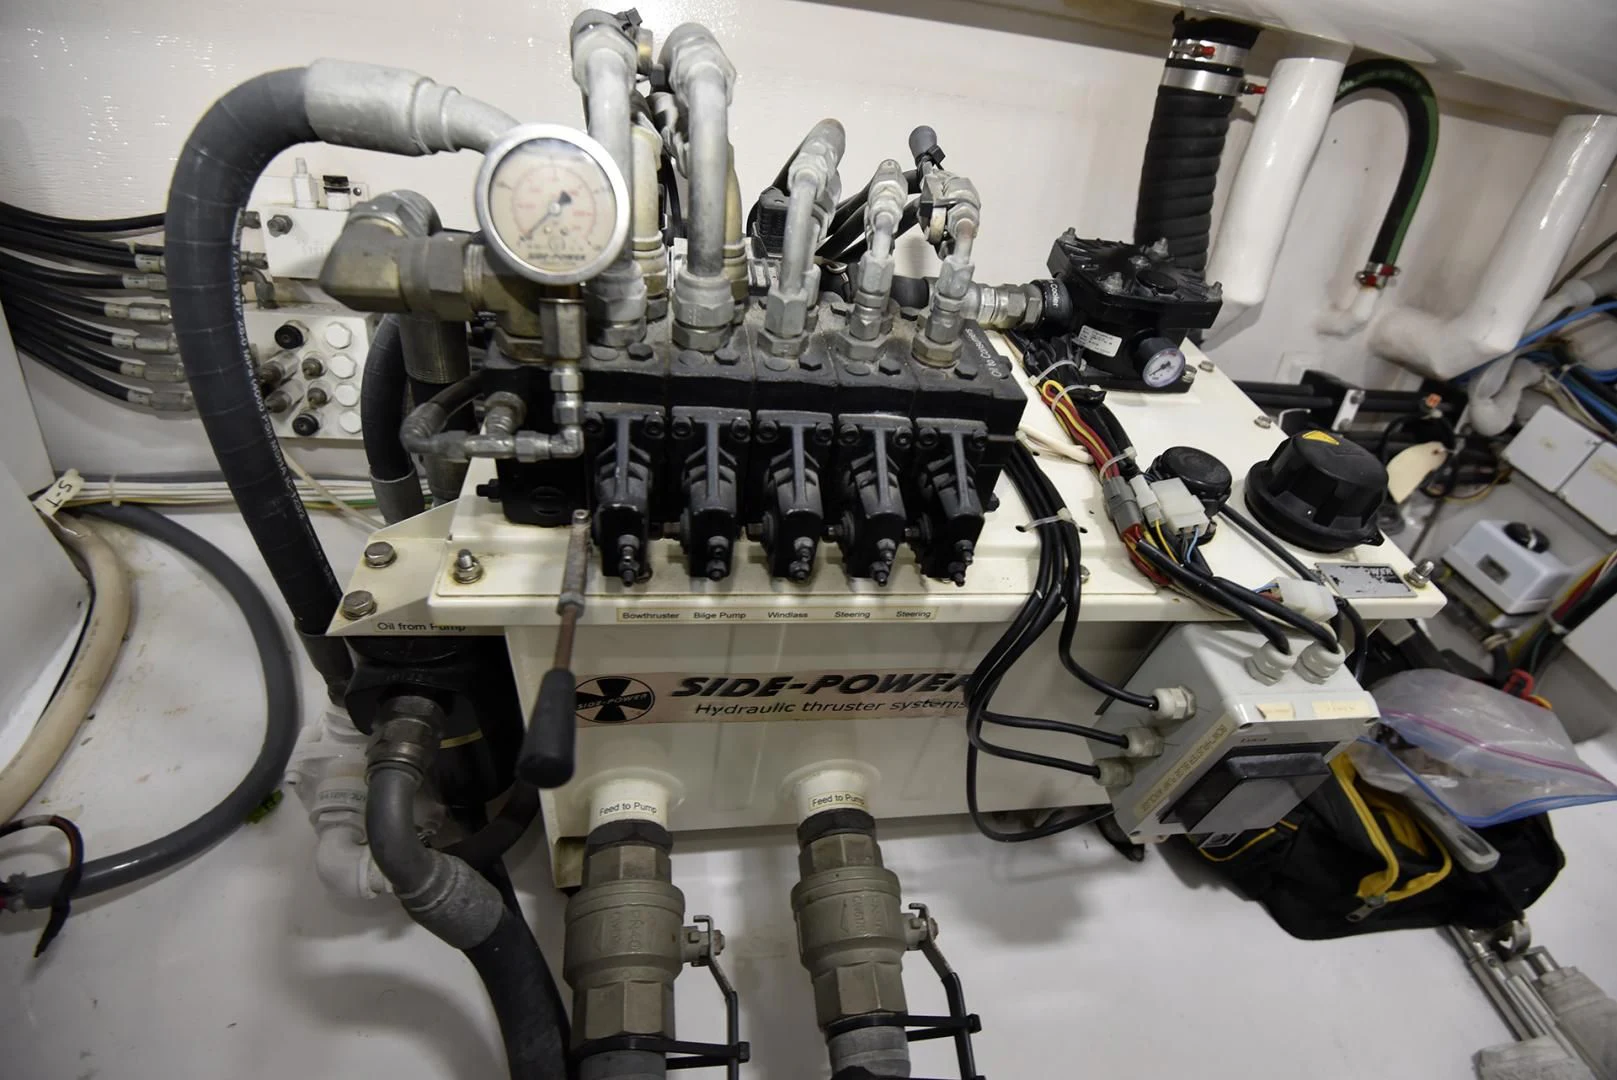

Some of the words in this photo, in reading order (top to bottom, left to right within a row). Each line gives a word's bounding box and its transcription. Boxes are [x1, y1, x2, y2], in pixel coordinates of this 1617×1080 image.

[1050, 283, 1060, 308] Cooler
[622, 611, 680, 619] Bowthruster
[693, 611, 717, 620] Bilge
[719, 611, 746, 620] Pump
[834, 610, 870, 619] Steering
[896, 610, 931, 619] Steering
[377, 622, 395, 631] Oil
[398, 622, 427, 631] from
[577, 693, 649, 709] SIDE-POWER
[695, 701, 796, 716] Hydraulic
[802, 701, 885, 712] thruster
[890, 699, 968, 711] systems
[600, 803, 620, 816] Feed
[634, 801, 657, 814] Pump
[812, 795, 833, 807] Feed
